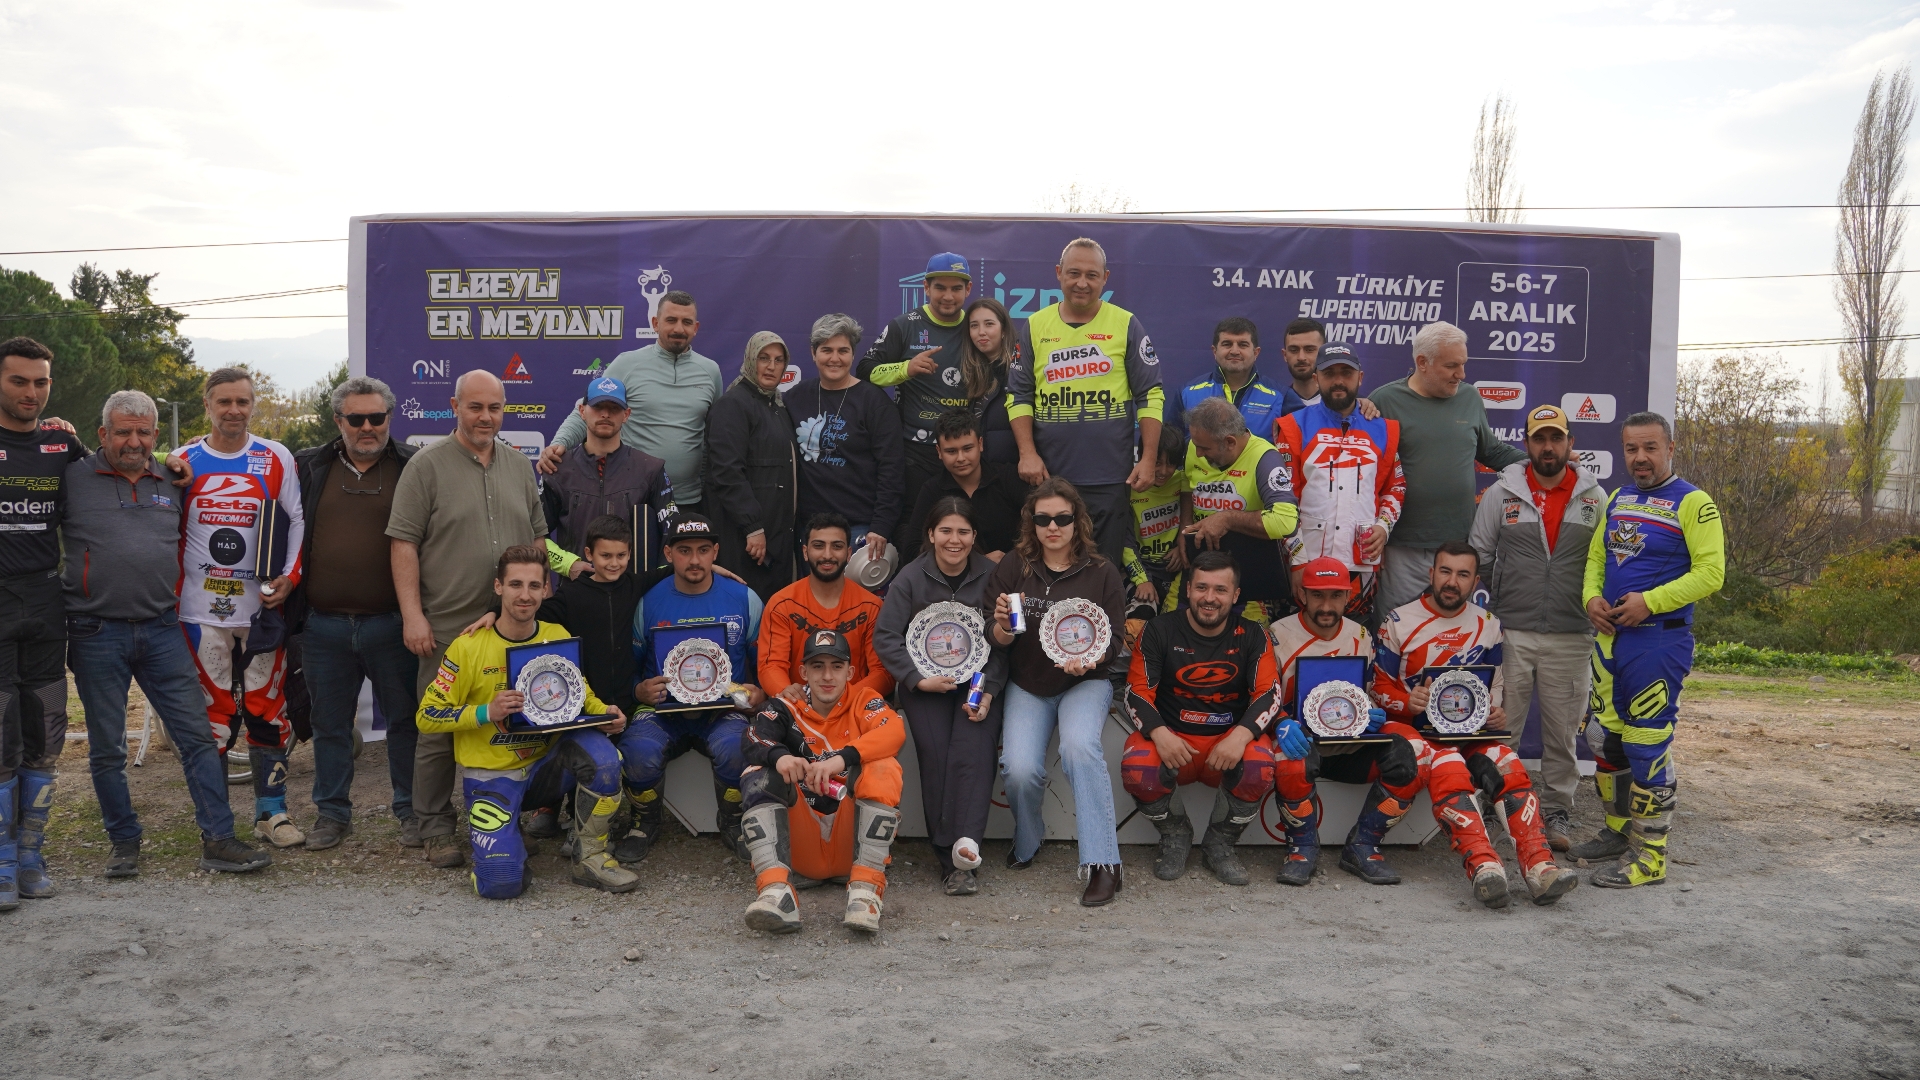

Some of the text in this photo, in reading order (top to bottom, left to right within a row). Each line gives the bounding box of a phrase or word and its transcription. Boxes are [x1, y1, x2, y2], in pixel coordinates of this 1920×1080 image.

[1212, 267, 1314, 289] 3.4. AYAK
[1336, 273, 1445, 297] TÜRKİYE
[1490, 272, 1558, 295] 5-6-7
[1298, 298, 1442, 322] SUPERENDURO
[1468, 300, 1577, 325] ARALIK
[426, 306, 624, 339] ER MEYDANI
[1488, 330, 1556, 353] 2025
[1051, 346, 1100, 364] BURSA
[1046, 361, 1111, 382] ENDURO
[503, 404, 546, 413] HERCO
[1317, 433, 1371, 447] Beta
[0, 476, 61, 487] HERCO
[1196, 483, 1234, 494] BURSA
[196, 498, 258, 511] Beta
[1143, 503, 1180, 522] BURSA
[1192, 494, 1244, 511] ENDURO
[201, 513, 253, 524] NITROMAC
[1139, 515, 1180, 537] ENDUR
[232, 570, 255, 579] market
[1255, 682, 1282, 731] Beta
